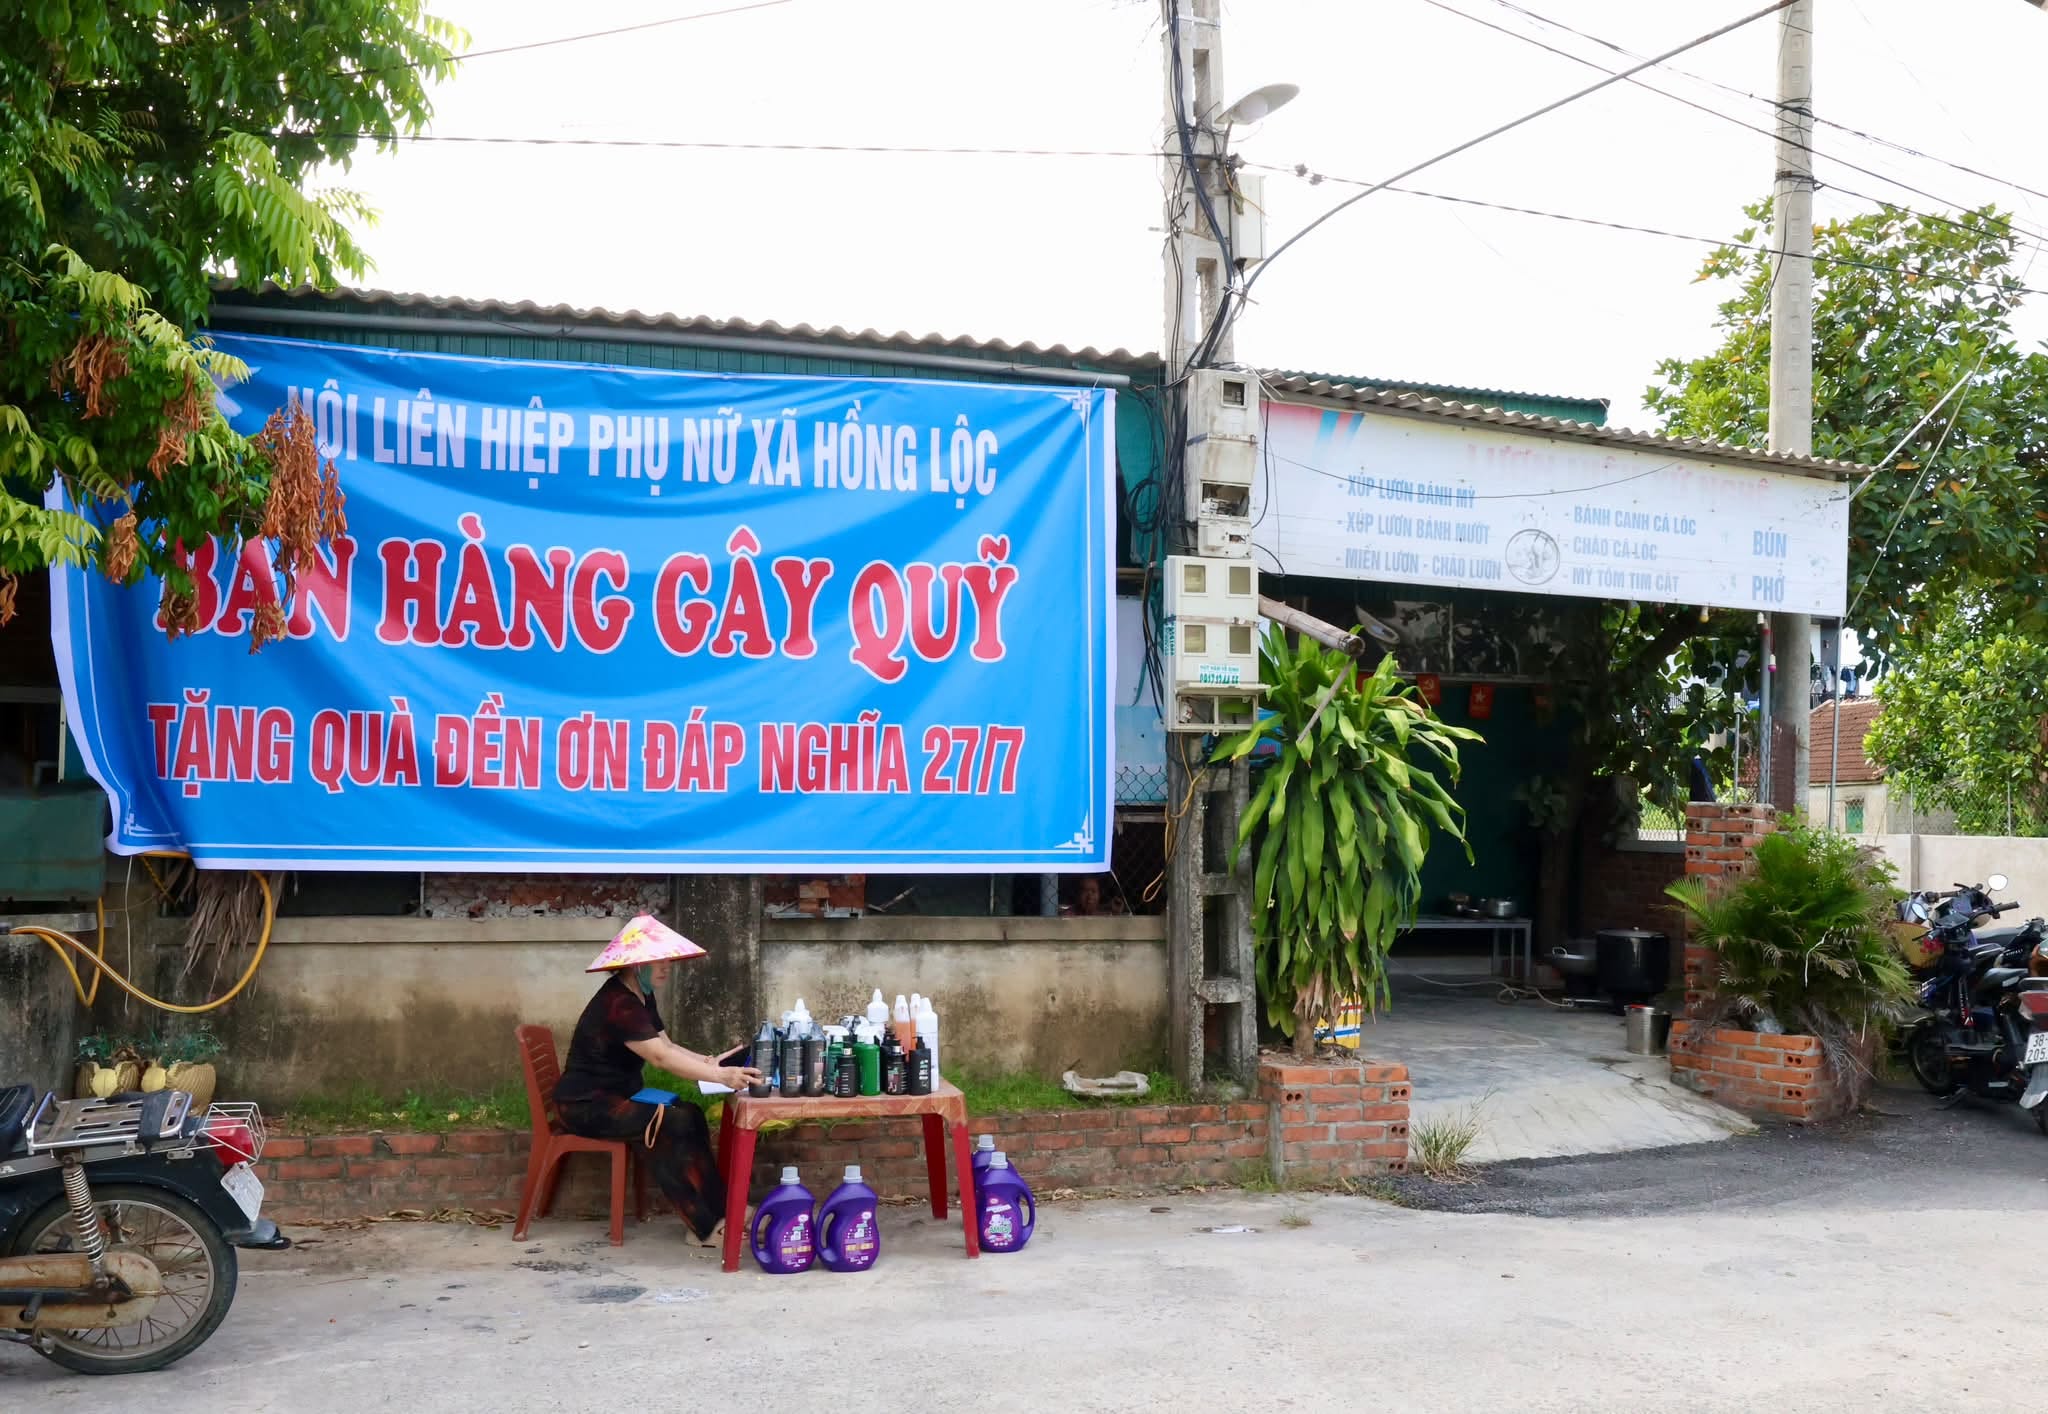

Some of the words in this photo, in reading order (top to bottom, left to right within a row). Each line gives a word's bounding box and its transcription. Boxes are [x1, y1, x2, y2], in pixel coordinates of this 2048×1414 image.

[373, 387, 467, 469] LIÊN
[480, 396, 576, 490] HIỆP
[588, 413, 669, 496] PHỤ
[682, 406, 744, 484] NỮ
[748, 408, 802, 488] XÃ
[813, 400, 918, 492] HỒNG
[929, 414, 999, 509] LỘC
[1615, 509, 1650, 531] CANH
[1752, 526, 1788, 558] BÚN
[376, 511, 635, 655] HÀNG
[652, 523, 835, 660] GÂY
[848, 534, 1019, 682] QUỸ
[1752, 568, 1786, 603] PHỞ
[147, 687, 295, 798] TẶNG
[310, 695, 421, 794] QUÀ
[432, 691, 543, 790] ĐỀN
[556, 711, 630, 792] ƠN
[642, 705, 745, 793] ĐÁP
[758, 708, 910, 794] NGHĨA
[920, 724, 1026, 795] 27/7
